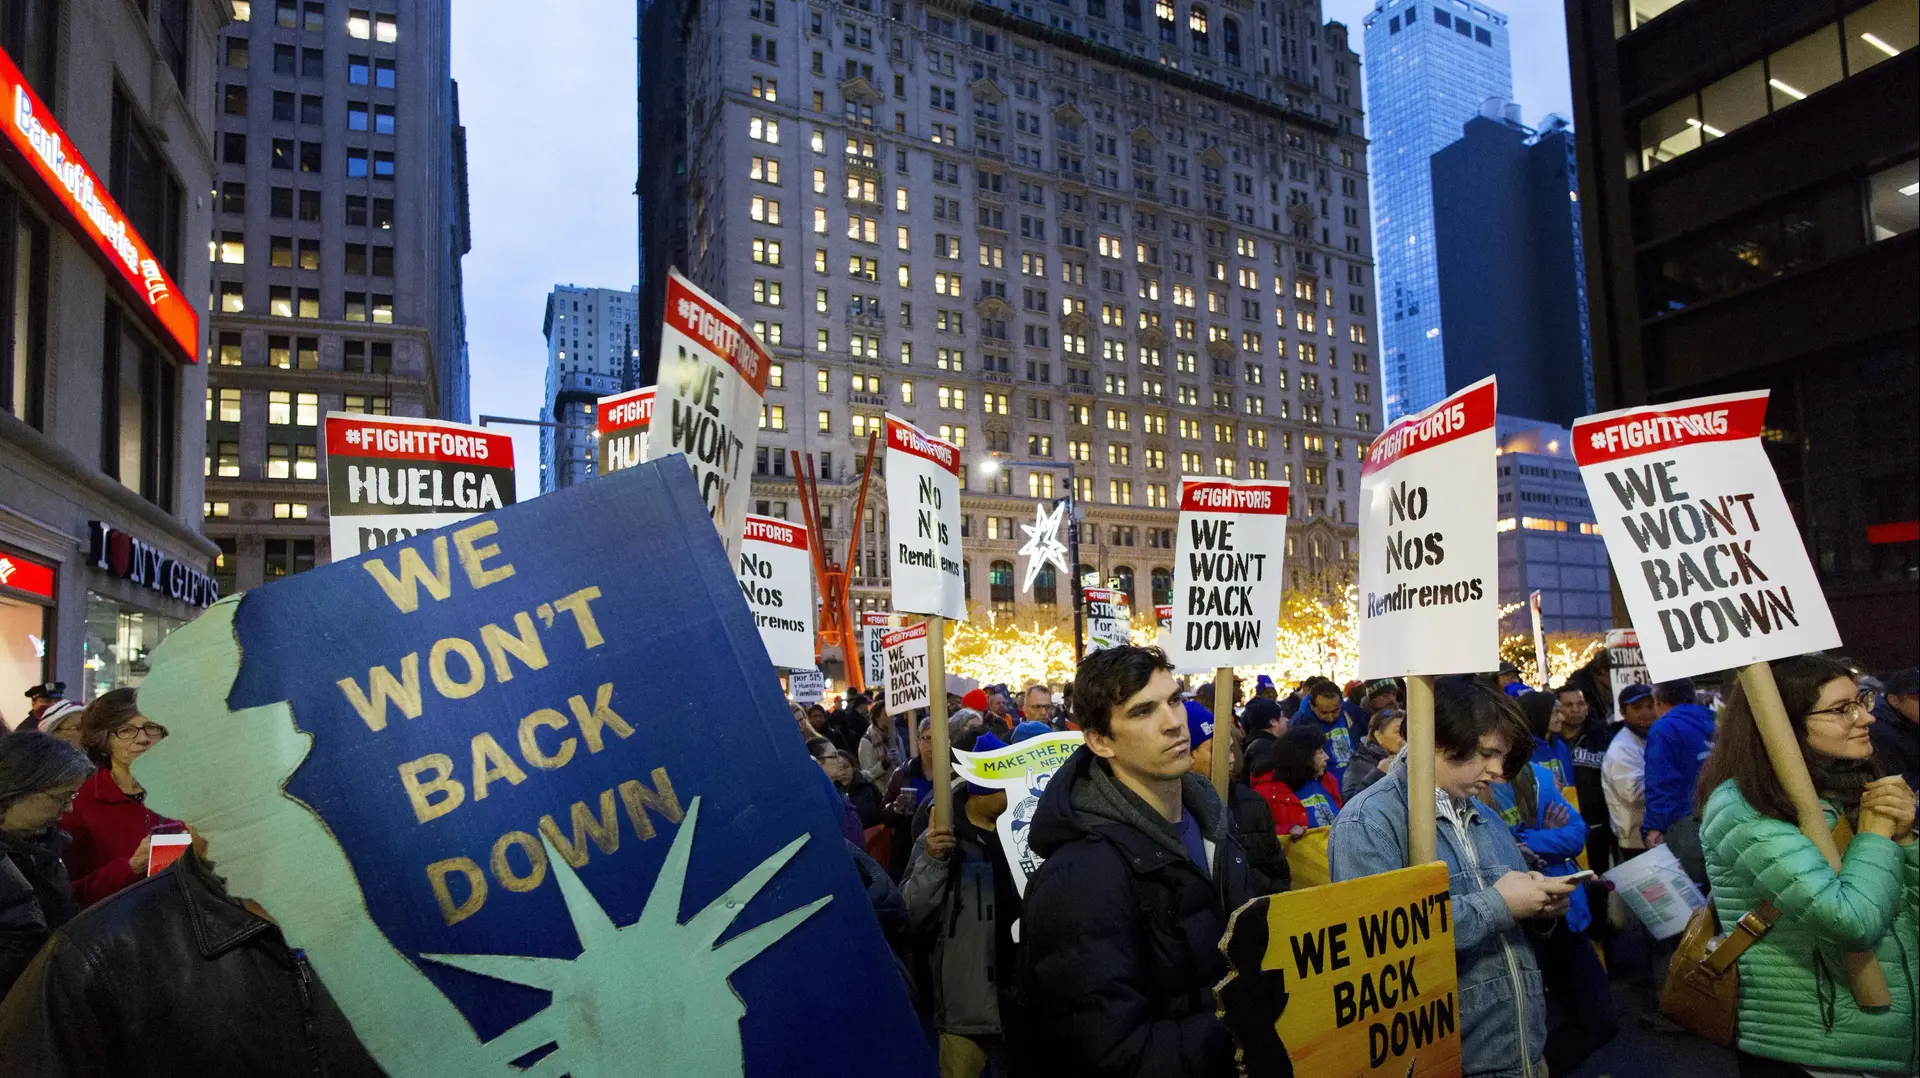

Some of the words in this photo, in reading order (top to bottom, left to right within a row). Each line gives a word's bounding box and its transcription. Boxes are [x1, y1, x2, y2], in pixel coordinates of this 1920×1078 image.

[14, 84, 66, 182] Bank
[64, 162, 85, 203] of
[80, 175, 139, 275] America
[677, 298, 760, 378] #FIGHTFOR15
[678, 344, 724, 418] WE
[608, 398, 654, 427] #FIGHT
[1590, 409, 1730, 453] #FIGHTFOR15
[345, 427, 489, 460] #FIGHTFOR15
[608, 431, 650, 472] HUE
[672, 398, 744, 481] WON'T
[895, 427, 953, 466] #FIGHTFOR15
[1370, 402, 1466, 465] #FIGHTFOR15
[348, 465, 504, 510] HUELGA
[919, 474, 942, 510] No
[1192, 487, 1272, 510] #FIGHTFOR15
[1388, 480, 1428, 526] No
[1604, 459, 1690, 511] WE
[744, 521, 793, 544] HTFOR15
[1190, 519, 1235, 552] WE
[1621, 493, 1761, 553] WON'T
[363, 520, 516, 614] WE
[740, 552, 772, 579] No
[899, 542, 960, 577] Rendiemos
[1189, 553, 1267, 582] WON'T
[1386, 530, 1445, 574] Nos
[1640, 540, 1769, 601] BACK
[130, 537, 165, 591] NY
[169, 560, 220, 609] GIFTS
[1188, 585, 1254, 617] BACK
[1367, 577, 1484, 619] Rendiremos
[886, 626, 926, 645] #FIGHTFOR15
[1094, 618, 1112, 632] for
[1185, 620, 1261, 651] DOWN
[1657, 585, 1800, 653] DOWN
[336, 585, 606, 732] WON'T
[888, 645, 905, 662] WE
[889, 654, 926, 676] WON'T
[1610, 648, 1645, 666] STRIK
[891, 670, 921, 691] BACK
[891, 685, 927, 707] DOWN
[1616, 669, 1630, 684] for
[397, 682, 636, 825] BACK
[983, 755, 1027, 772] MAKE
[1027, 743, 1056, 761] THE
[1060, 743, 1080, 753] RO
[425, 767, 686, 926] DOWN
[1290, 922, 1350, 980] WE
[1358, 890, 1451, 958] WON'T
[1333, 955, 1420, 1029] BACK
[1368, 992, 1455, 1069] DOWN
